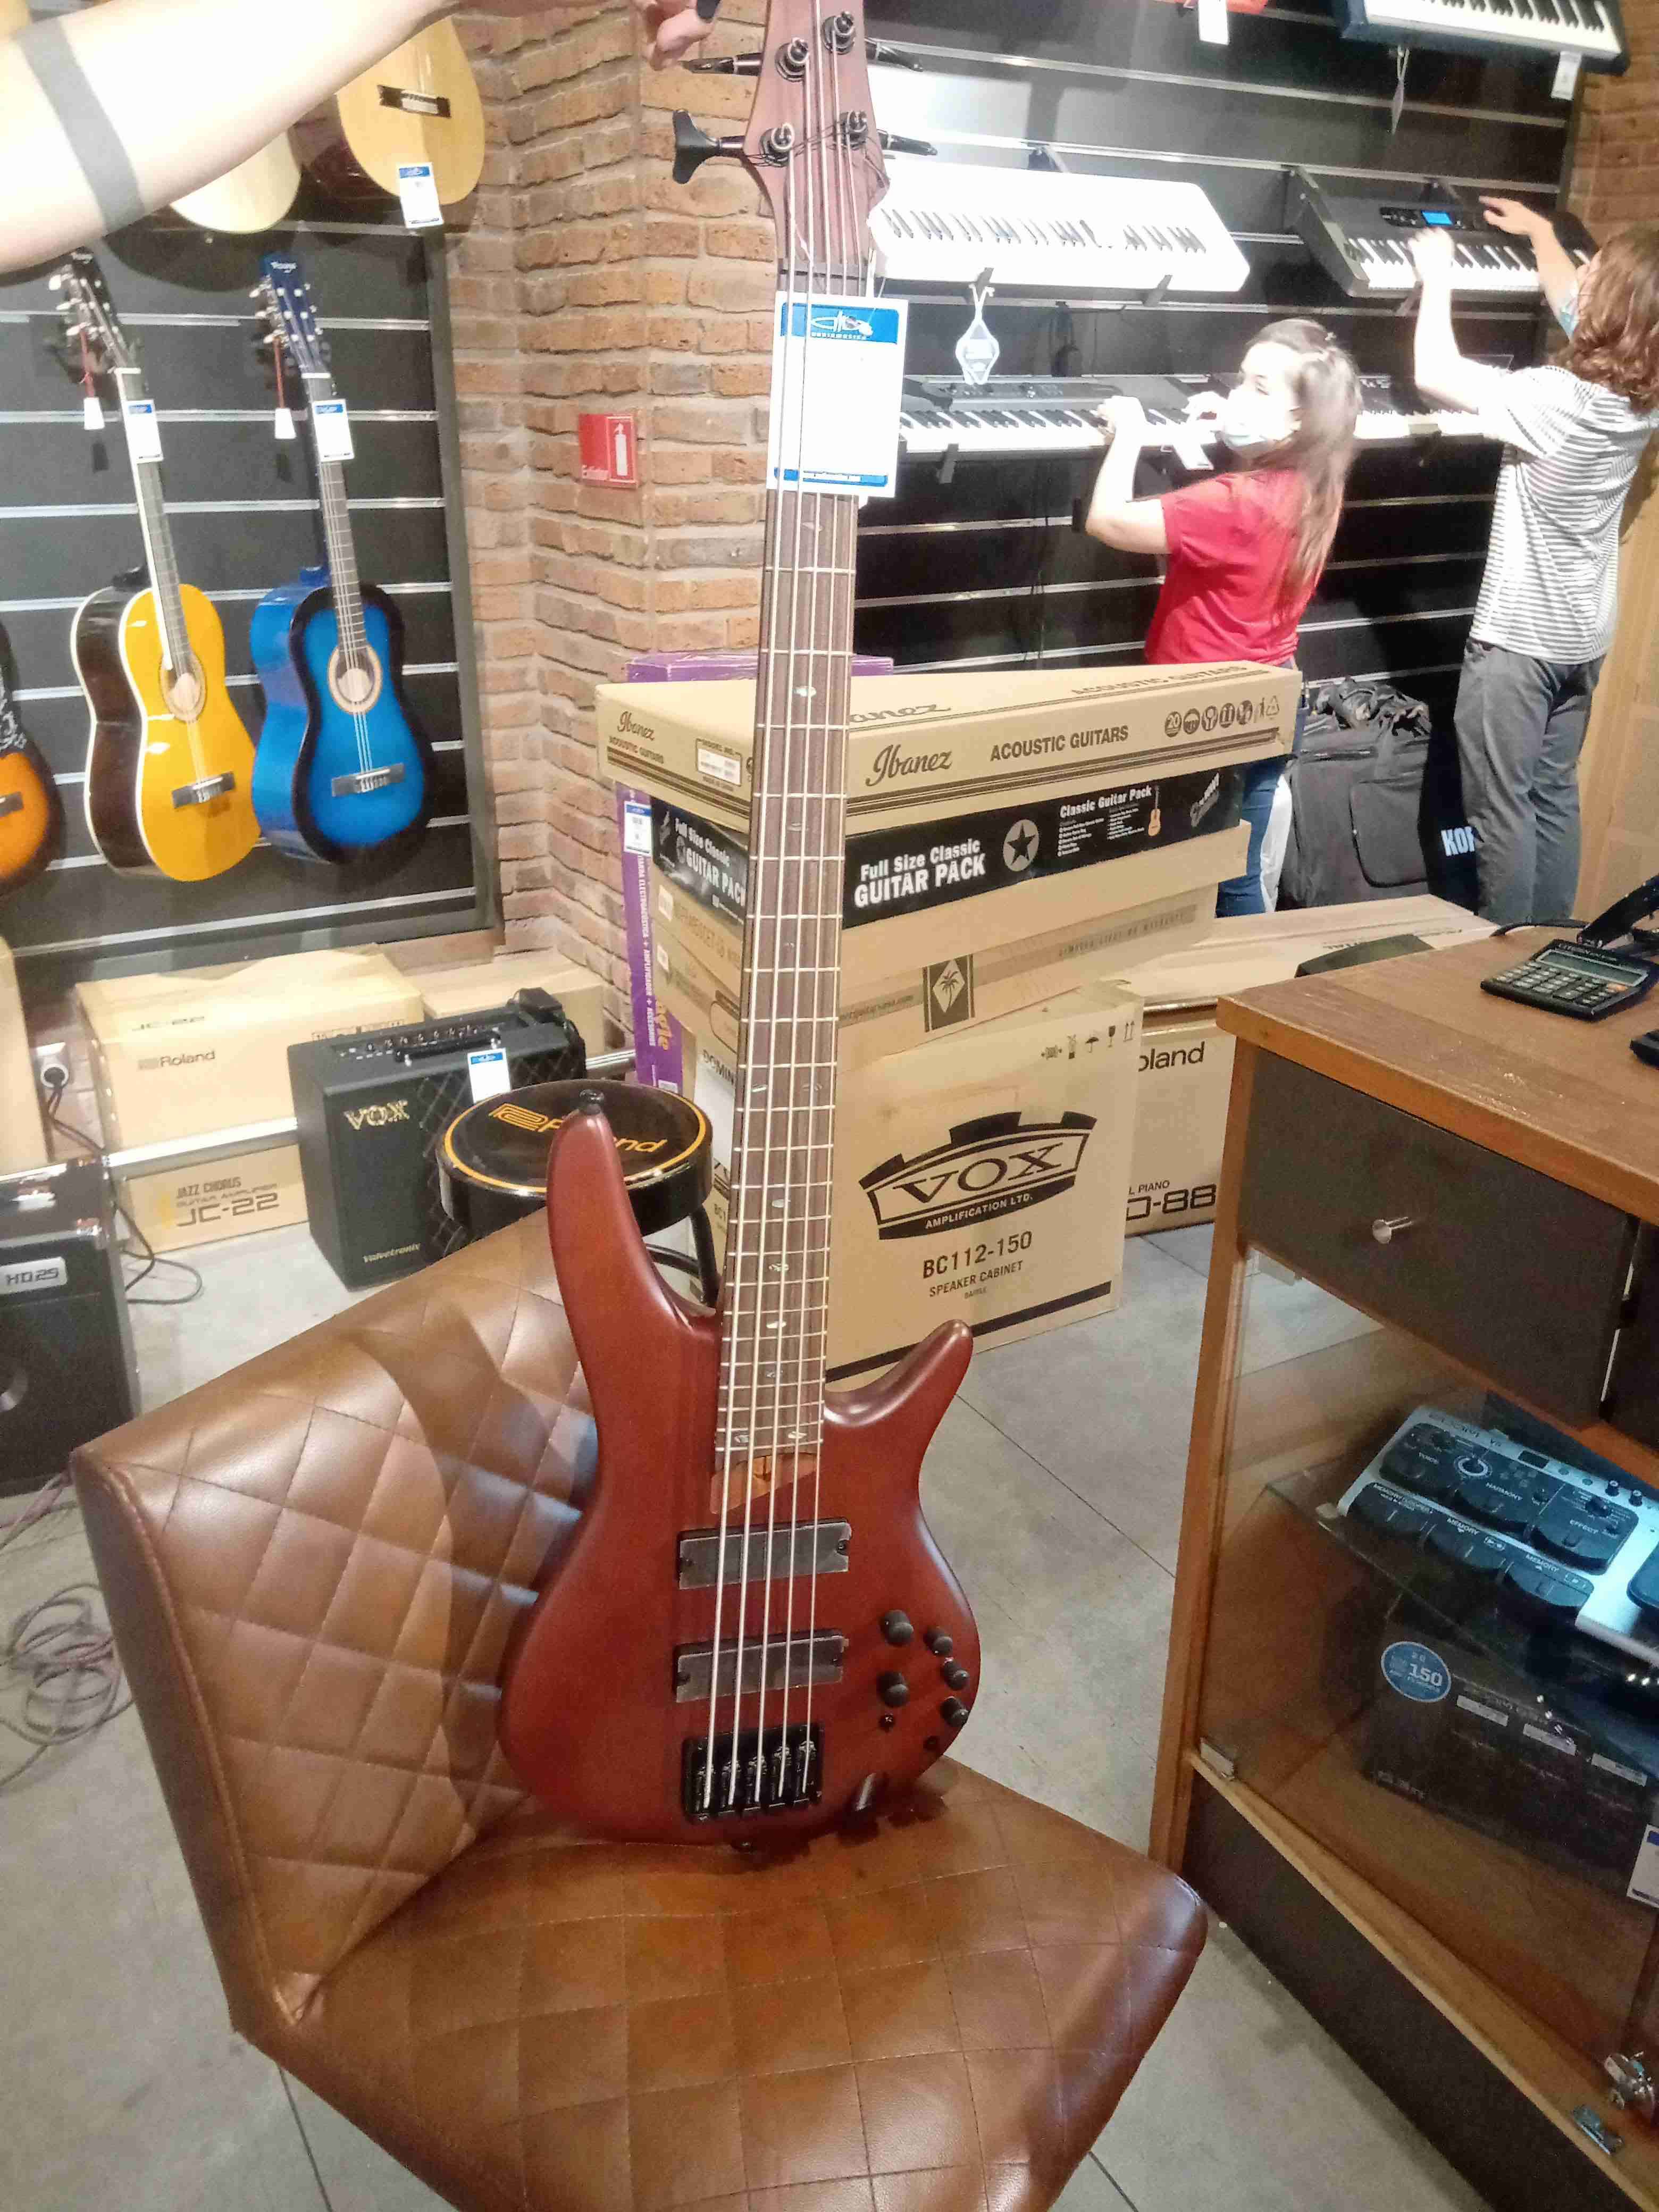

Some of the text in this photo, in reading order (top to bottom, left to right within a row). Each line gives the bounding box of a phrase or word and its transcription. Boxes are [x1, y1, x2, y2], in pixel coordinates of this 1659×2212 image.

[617, 711, 655, 741] Ibanez
[866, 725, 1128, 786] Ibanez ACOUSTIC GUITARS
[1060, 785, 1152, 818] Classic Guitar Pack
[686, 848, 719, 887] GUITAR
[860, 839, 981, 881] Full Size Classic
[854, 853, 985, 908] GUITAR PACK
[160, 1050, 215, 1067] Roland
[345, 1100, 409, 1130] VOX
[893, 1142, 1063, 1203] VOX
[1138, 1179, 1170, 1194] PIANO
[177, 1177, 242, 1199] JAZZ CHORUS
[177, 1192, 280, 1227] JC-22
[925, 1193, 1033, 1229] AMPLIFICATION LTD.
[363, 1243, 421, 1263] Valvetronix
[923, 1230, 1032, 1279] BC112-150
[929, 1260, 1023, 1297] SPEAKER CABINET
[1486, 1482, 1523, 1501] HARMONY
[1447, 1517, 1480, 1536] MEMORY
[1570, 1519, 1599, 1534] EFFECT
[1526, 1554, 1561, 1572] MEMORY
[1409, 1663, 1443, 1687] 150
